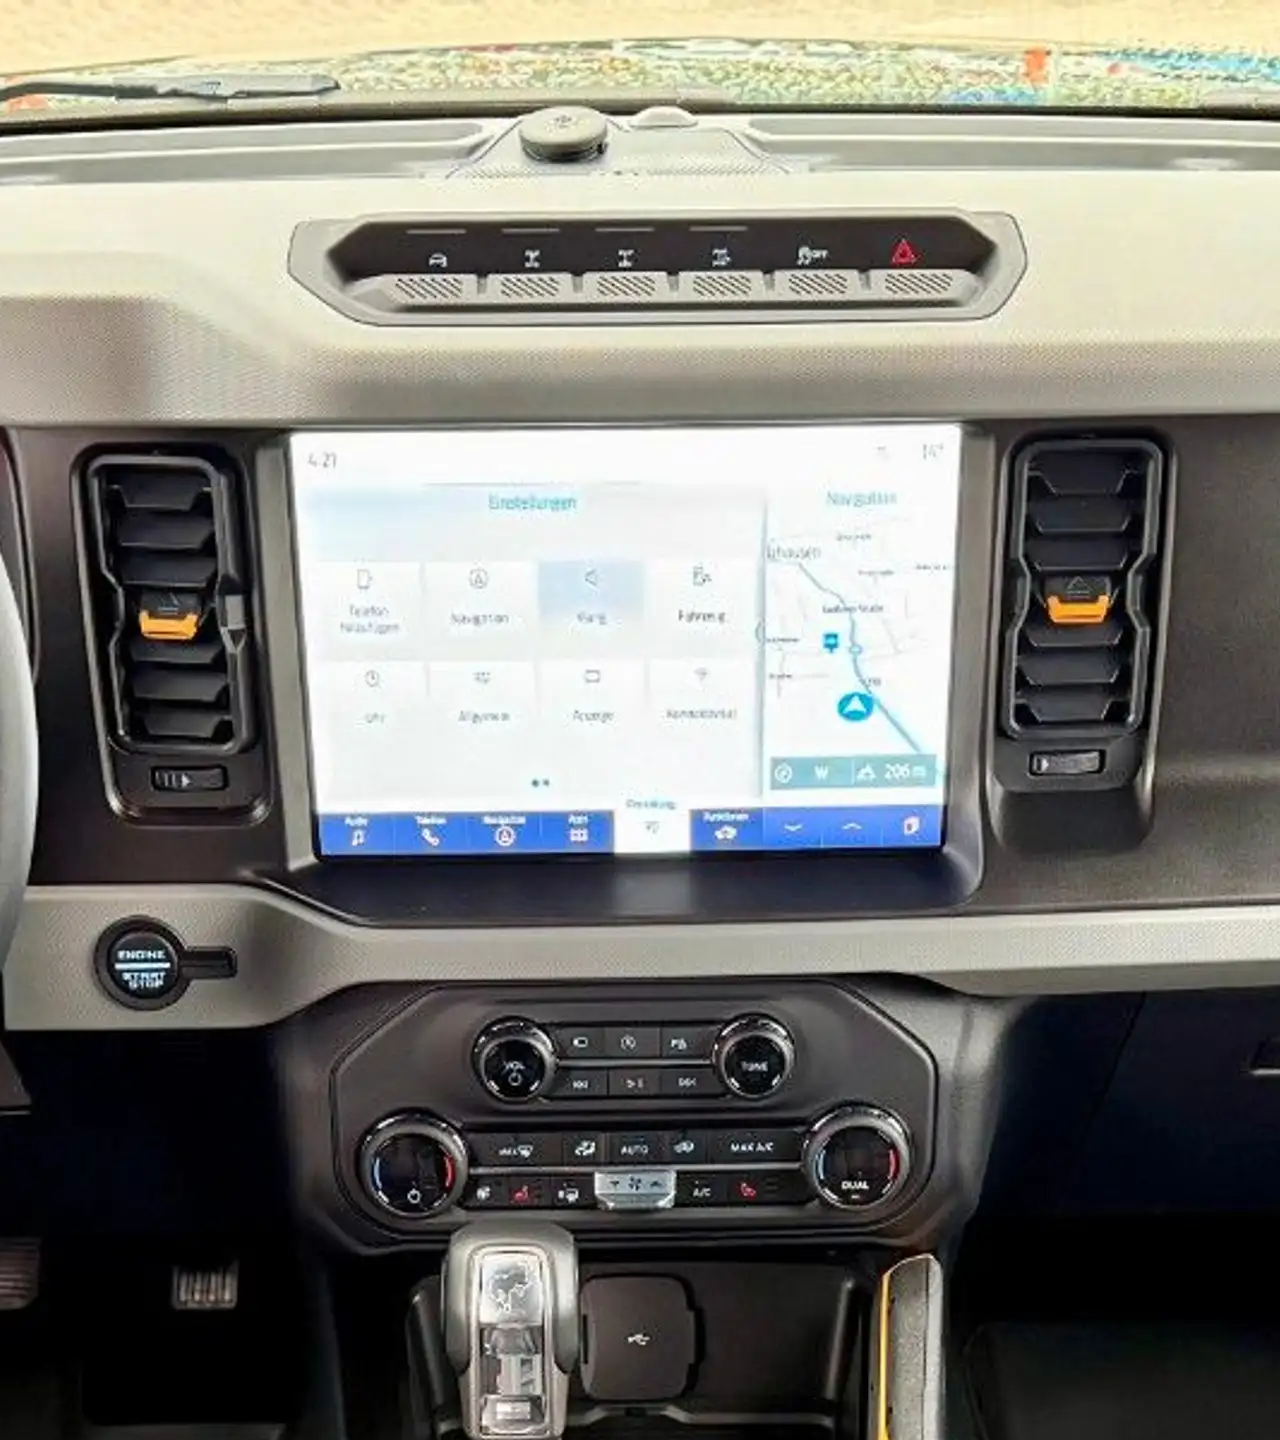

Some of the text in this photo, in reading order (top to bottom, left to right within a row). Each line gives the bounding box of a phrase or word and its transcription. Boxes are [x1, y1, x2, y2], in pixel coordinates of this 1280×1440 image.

[488, 492, 577, 511] Einstellungen
[884, 764, 910, 781] 206
[117, 950, 166, 960] ENGINE
[122, 971, 167, 981] START
[742, 1060, 769, 1073] TUNE
[621, 1144, 649, 1156] AUTO
[730, 1141, 774, 1152] MAX A/C
[841, 1180, 870, 1191] DUAL
[692, 1186, 711, 1198] A/C
